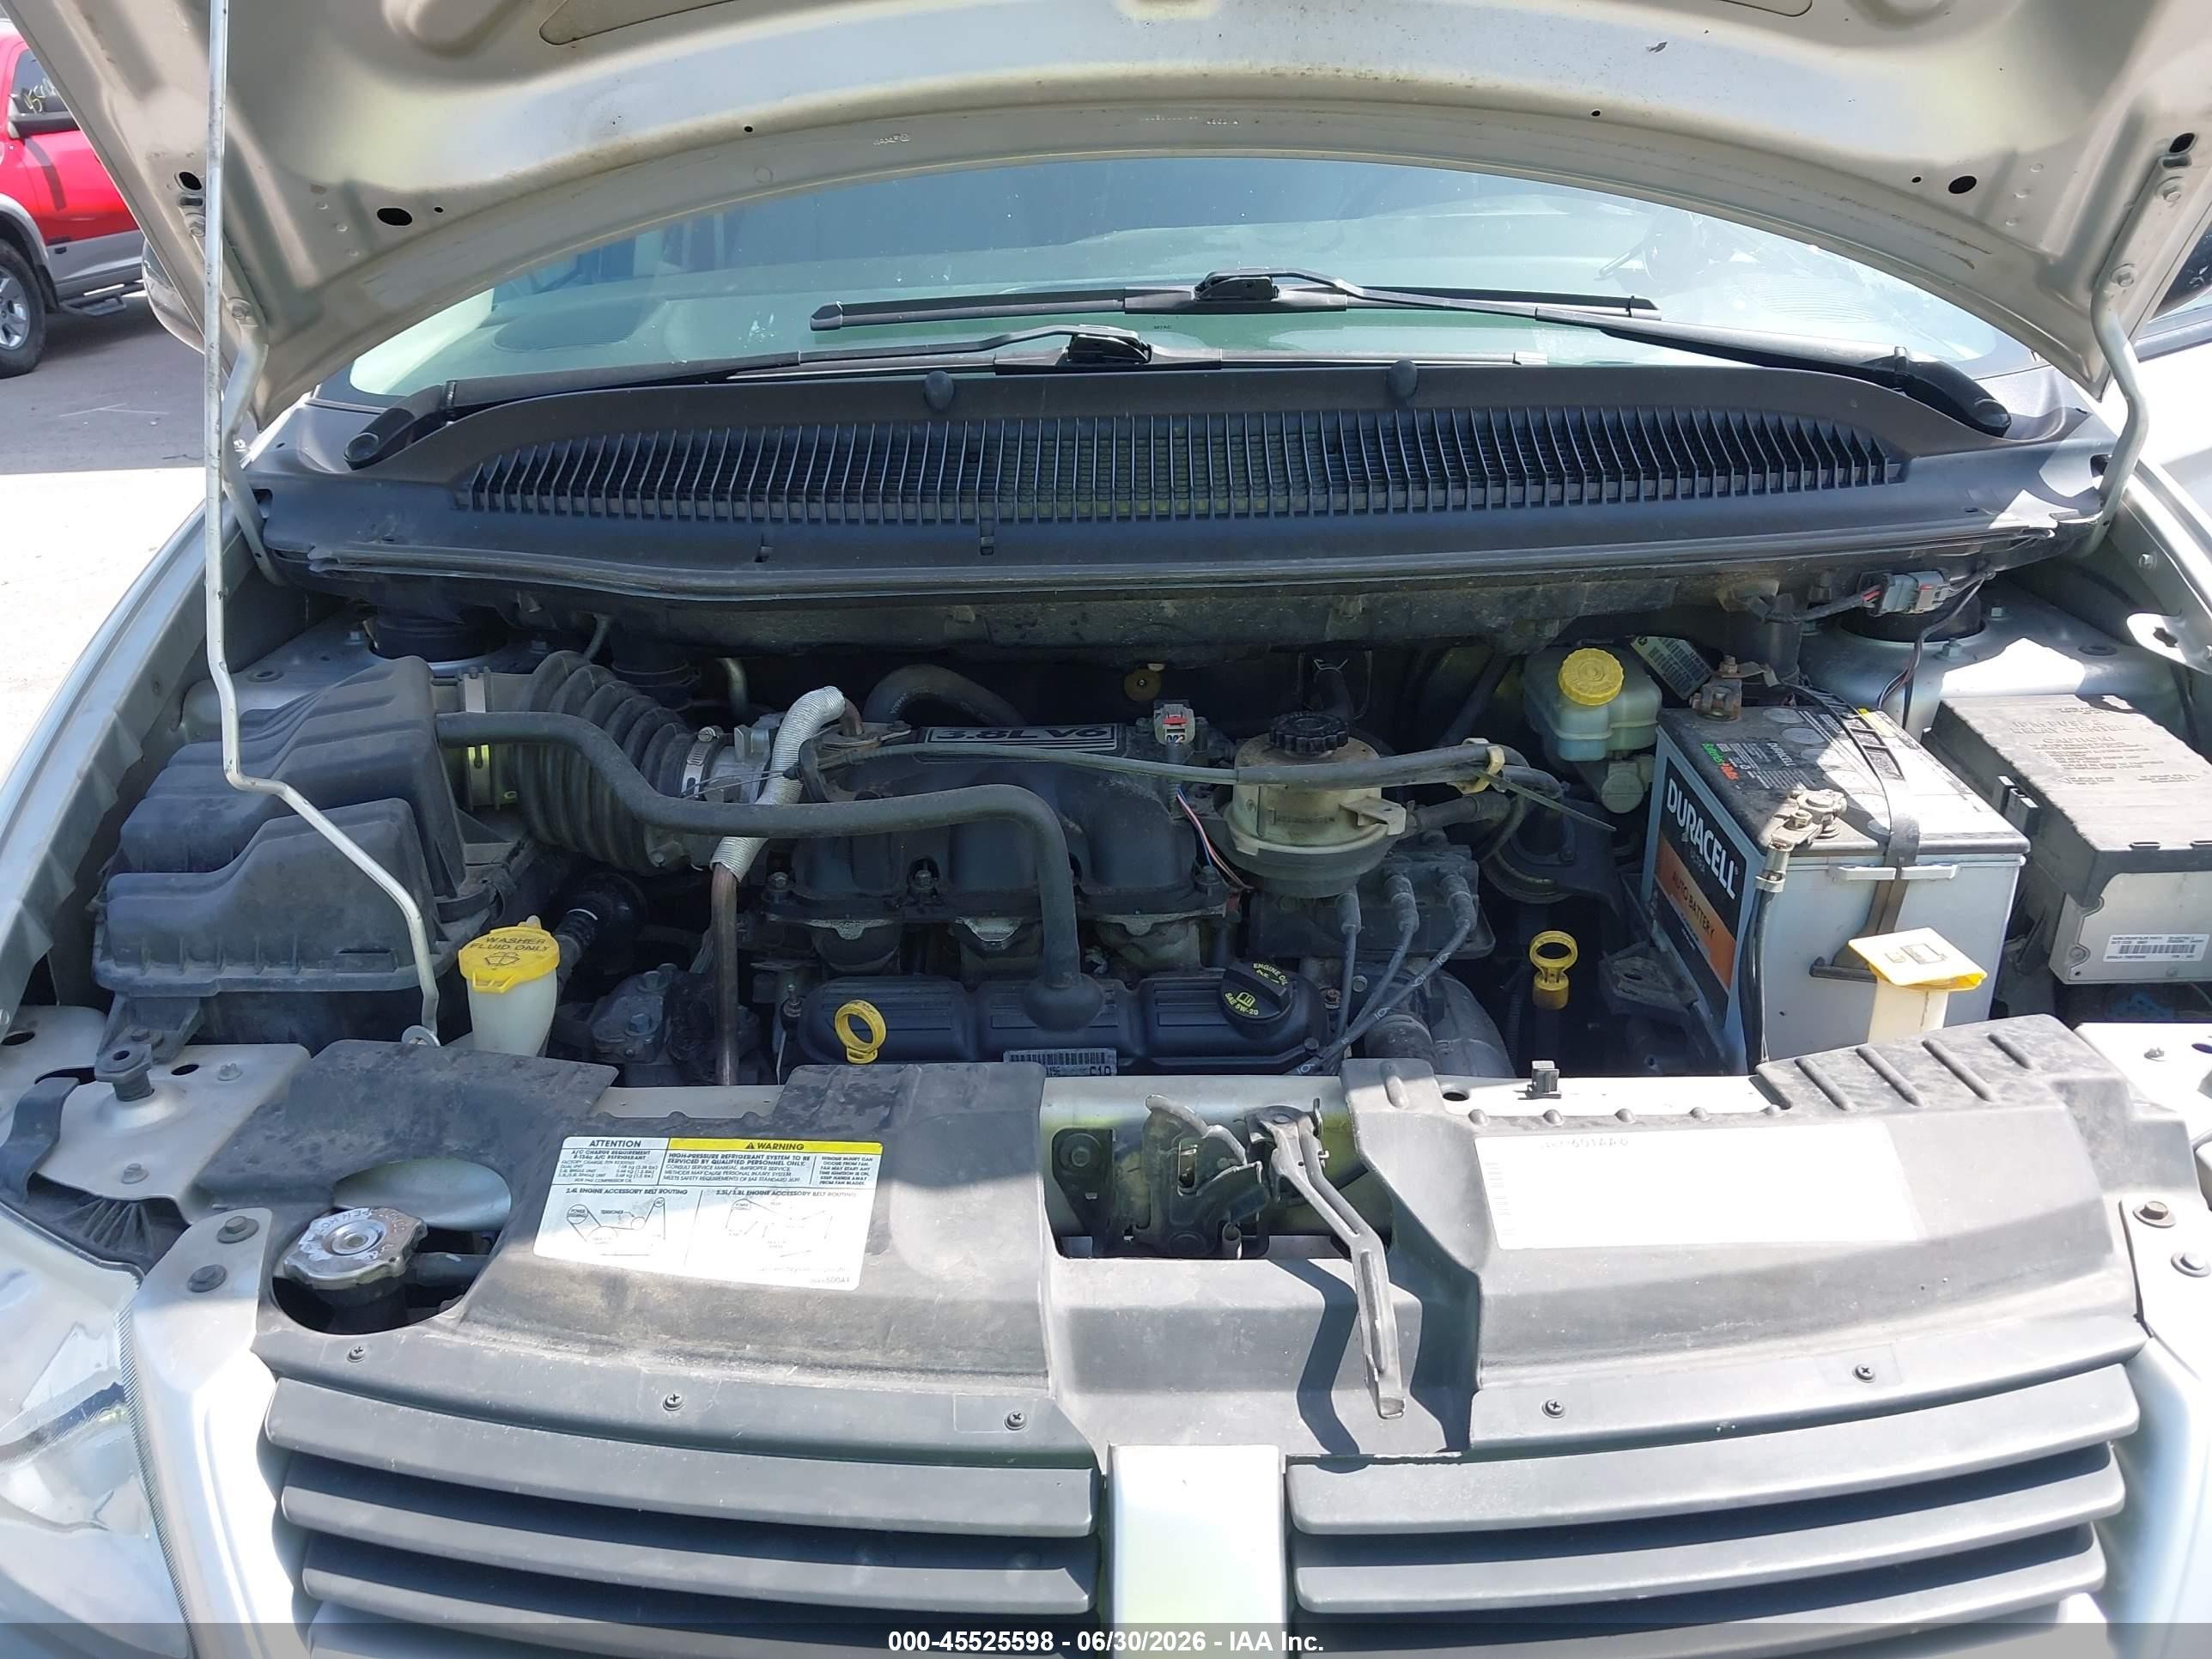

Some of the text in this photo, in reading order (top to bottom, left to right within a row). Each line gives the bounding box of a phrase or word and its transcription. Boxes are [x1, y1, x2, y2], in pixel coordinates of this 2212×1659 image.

[936, 729, 1108, 739] 3.8L V6
[1666, 777, 1736, 900] DURACELL
[1688, 894, 1716, 939] BATTERY
[1253, 963, 1289, 986] ENGINE OIL
[1224, 993, 1259, 1016] SAE 5W-20
[757, 1142, 804, 1151] WARNING
